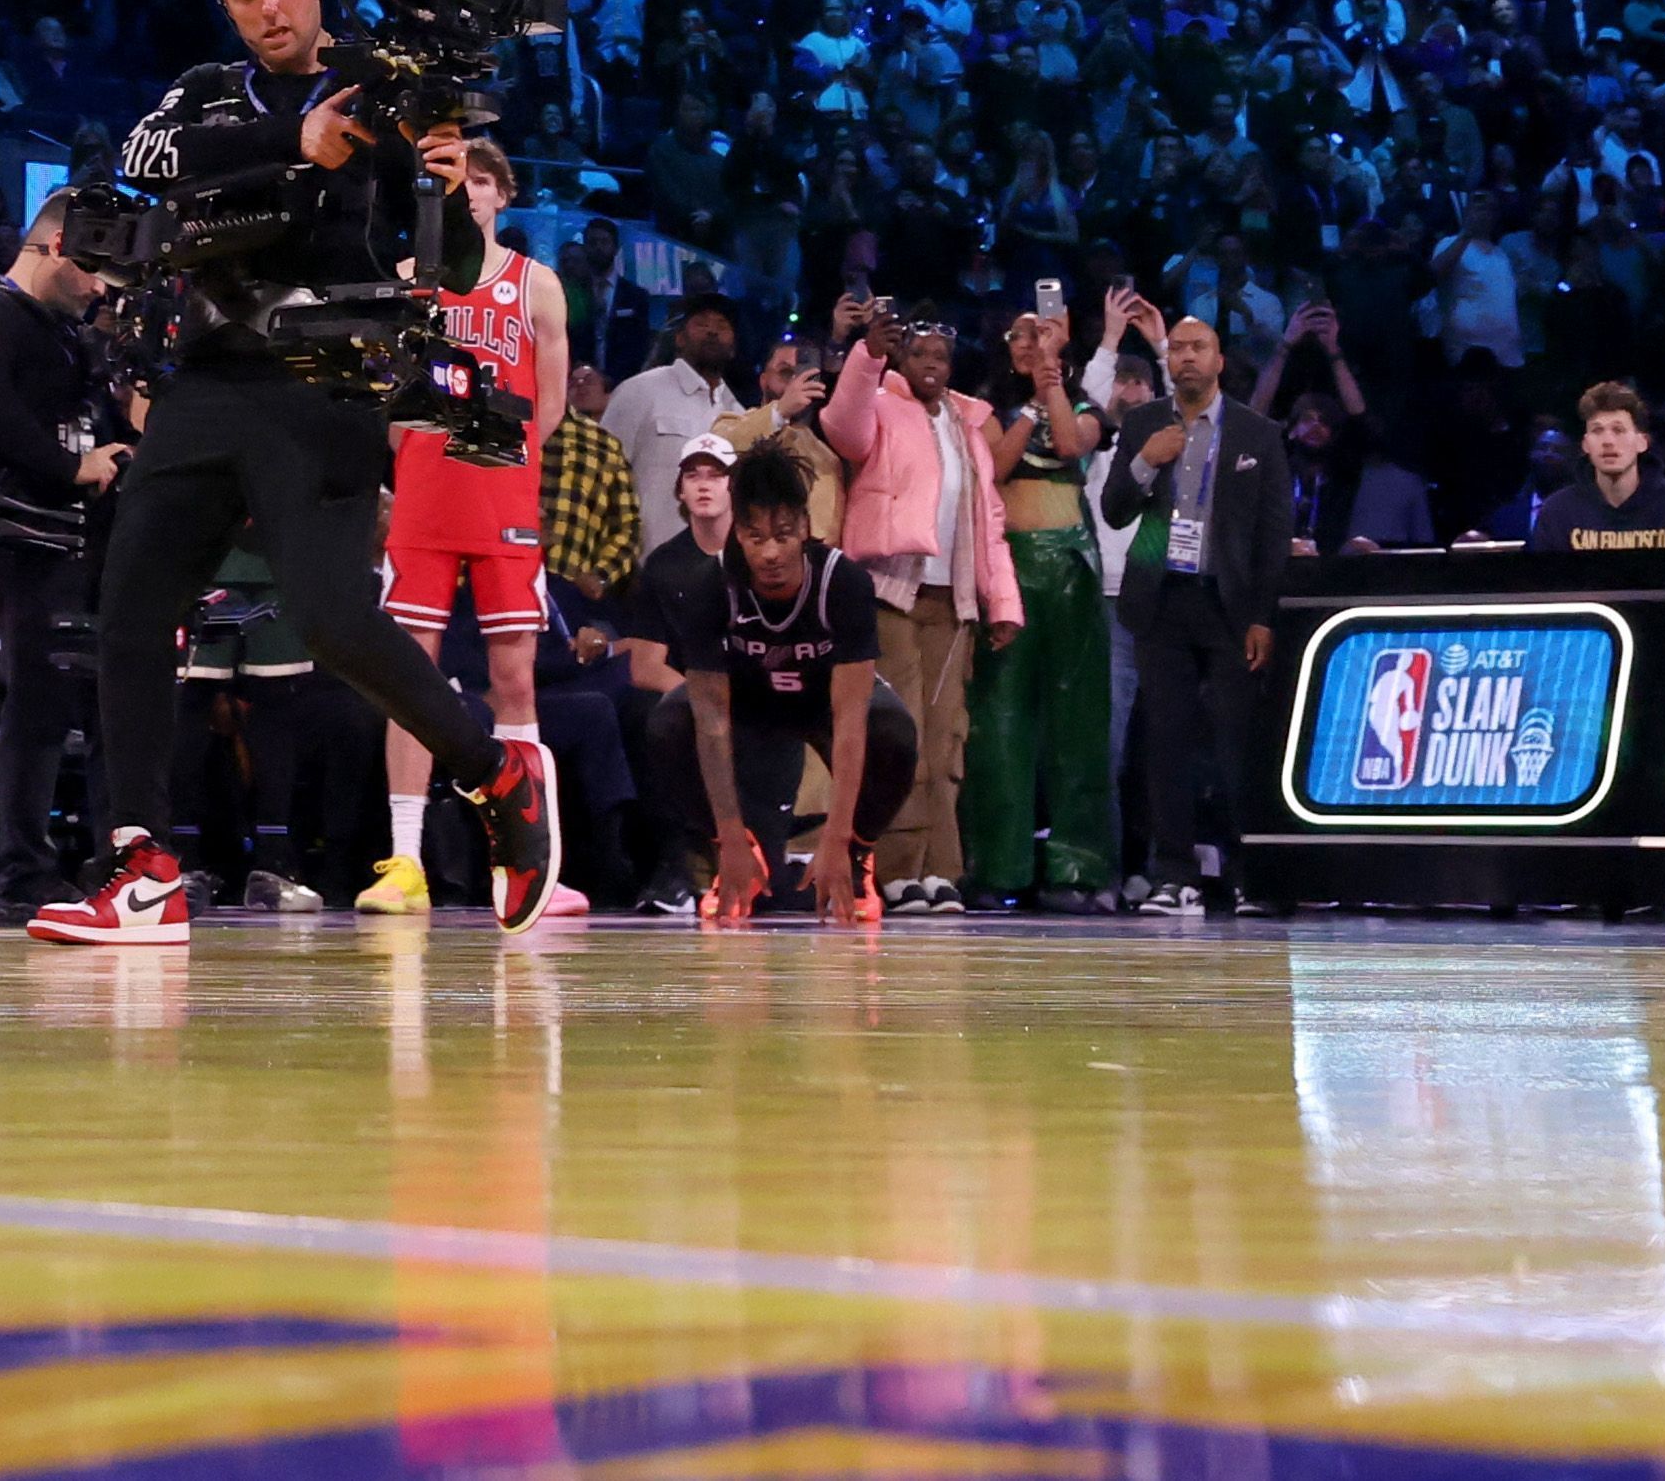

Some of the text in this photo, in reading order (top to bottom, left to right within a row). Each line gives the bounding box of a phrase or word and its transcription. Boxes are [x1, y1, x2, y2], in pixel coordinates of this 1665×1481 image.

[122, 125, 184, 179] 025
[440, 306, 523, 366] ULLS
[770, 671, 803, 692] 5
[1473, 648, 1526, 669] AT&T
[1432, 675, 1523, 732] SLAM
[1422, 732, 1514, 787] DUNK
